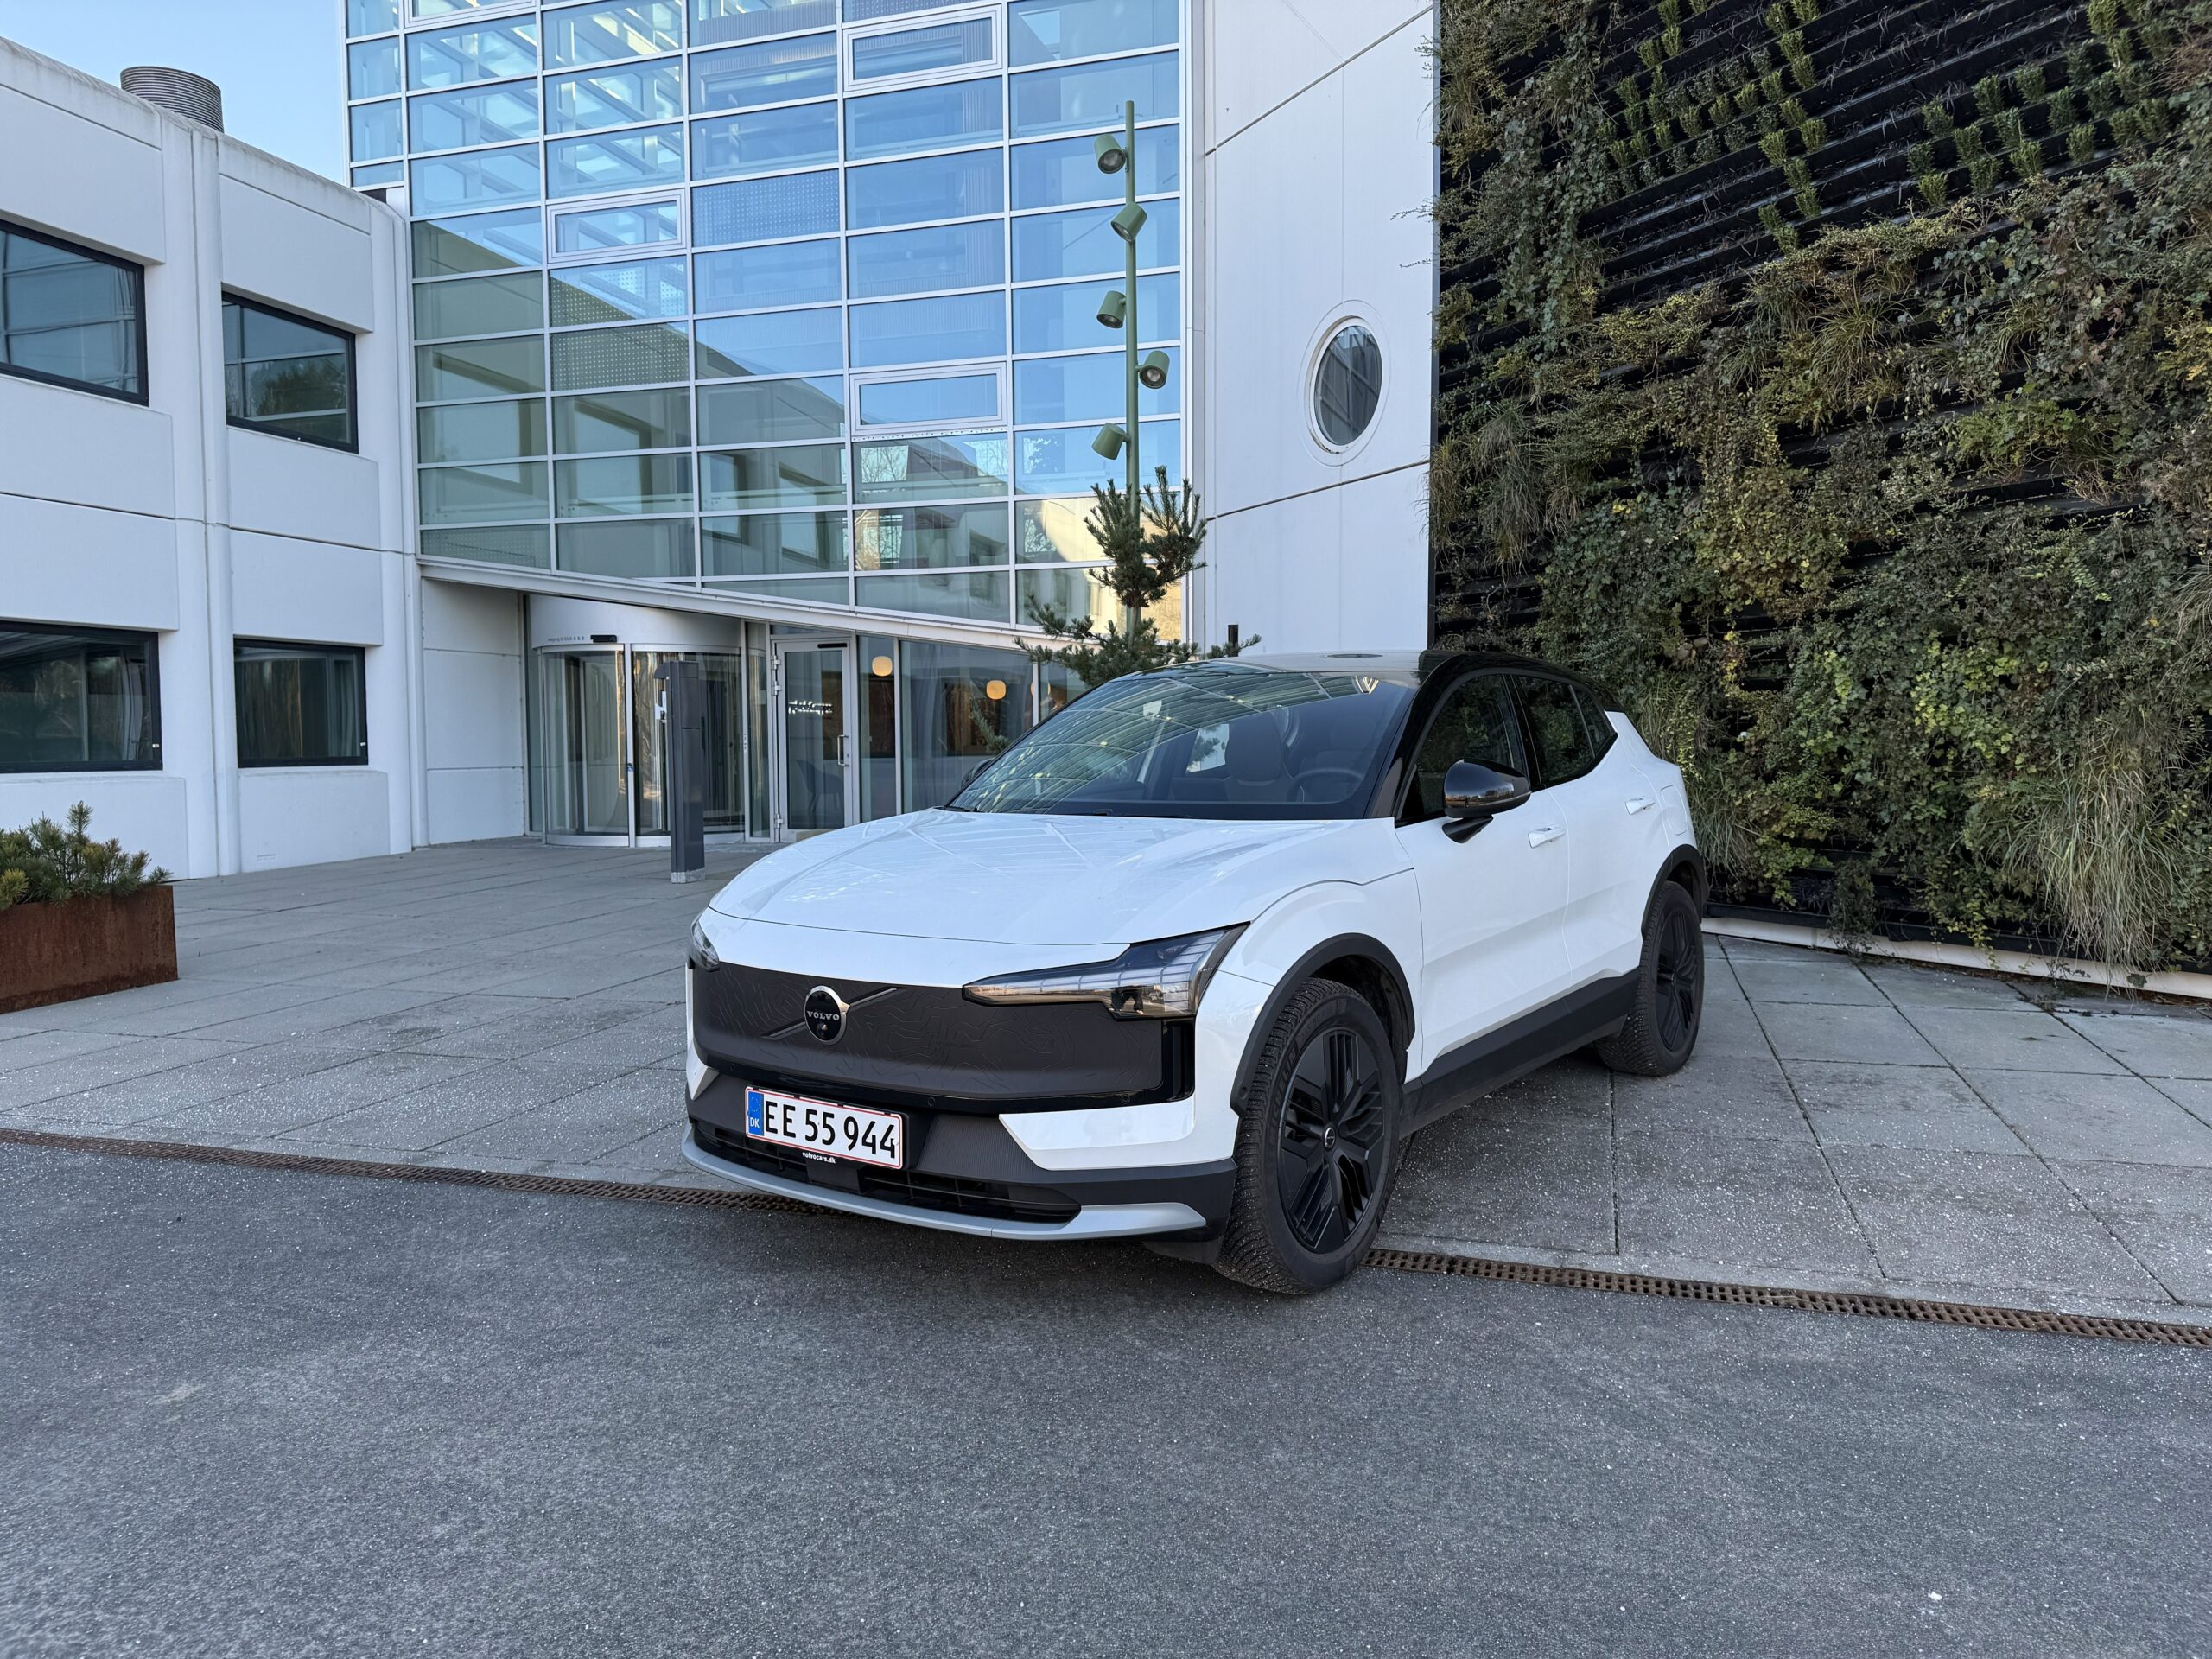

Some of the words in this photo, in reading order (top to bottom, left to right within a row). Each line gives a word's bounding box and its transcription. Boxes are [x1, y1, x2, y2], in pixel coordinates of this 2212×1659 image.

[807, 1011, 840, 1020] VOLVO
[750, 1116, 760, 1128] DK
[765, 1100, 797, 1139] EE
[805, 1109, 836, 1146] 55
[843, 1116, 895, 1159] 944
[802, 1152, 836, 1164] volvocars.dk
